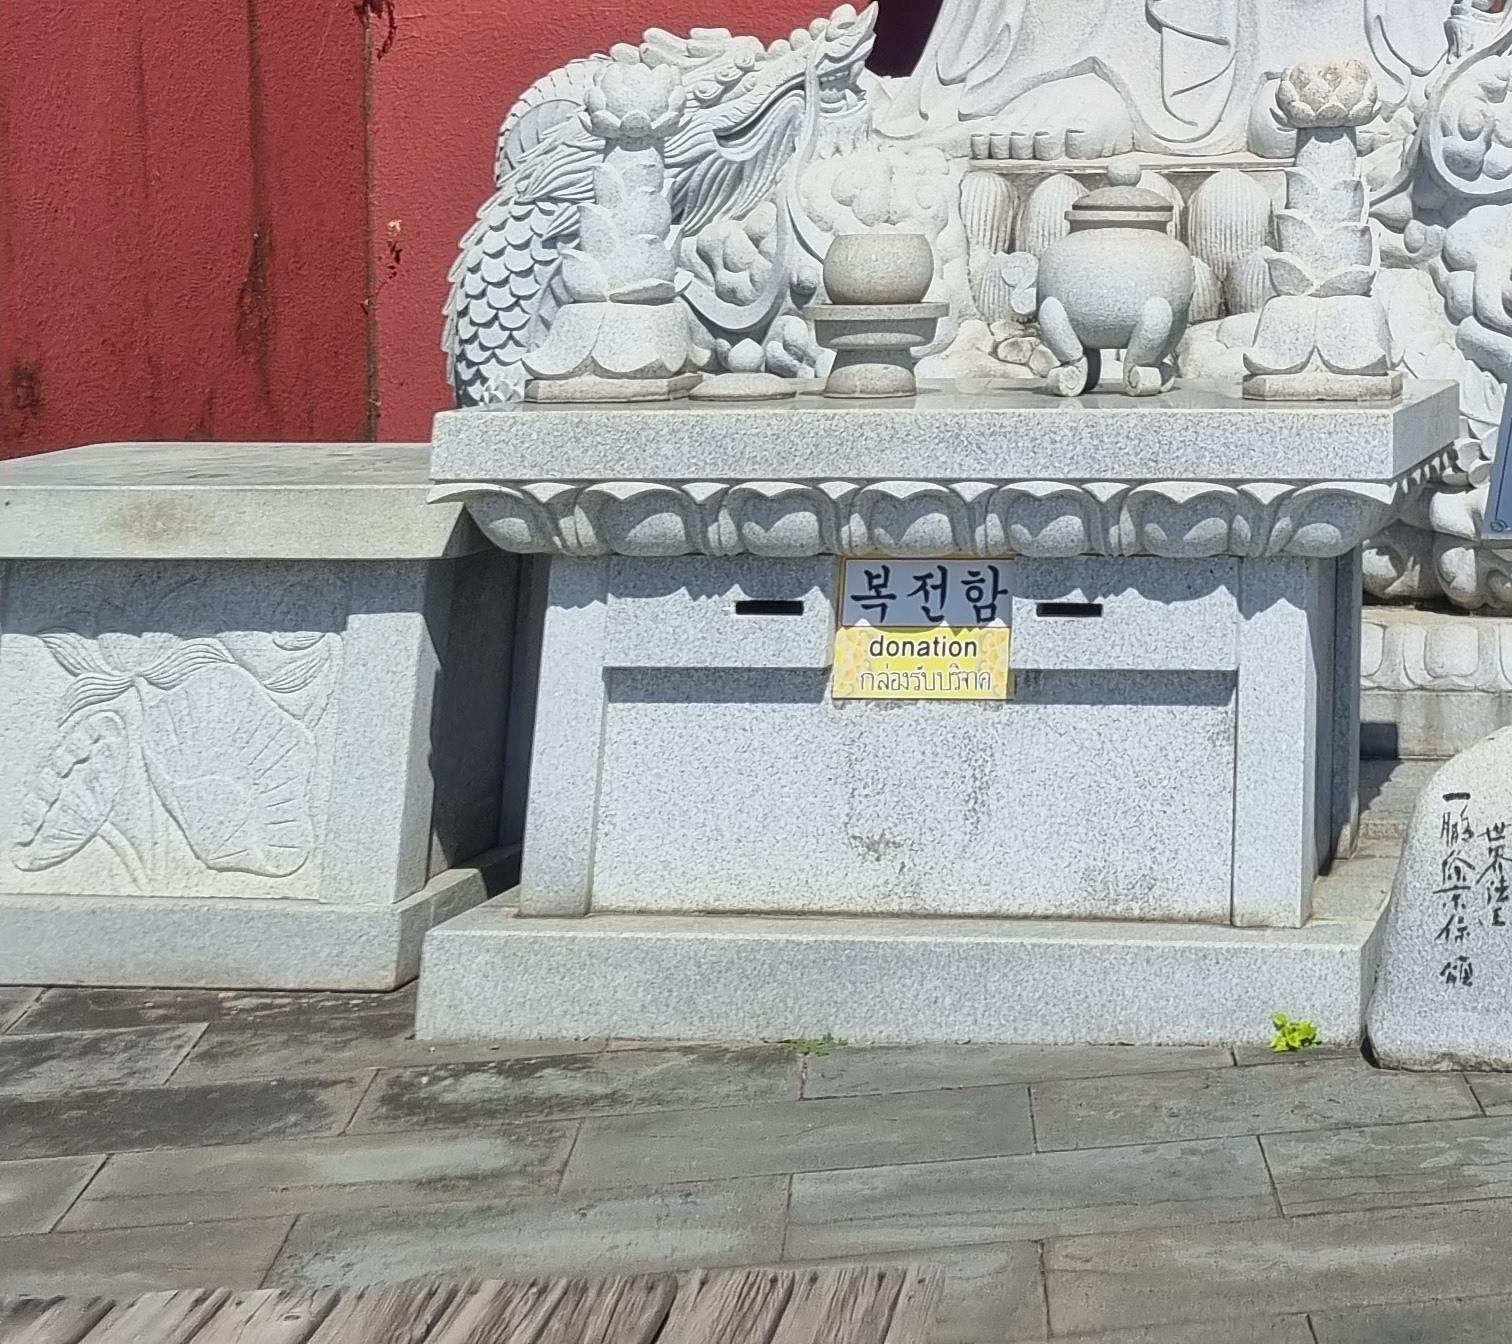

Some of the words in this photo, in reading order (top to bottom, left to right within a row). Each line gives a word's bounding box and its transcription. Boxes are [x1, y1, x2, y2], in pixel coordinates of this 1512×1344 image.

[850, 564, 1009, 624] 복전함
[869, 634, 978, 658] donation
[860, 662, 991, 692] กล่องรับบริจาค
